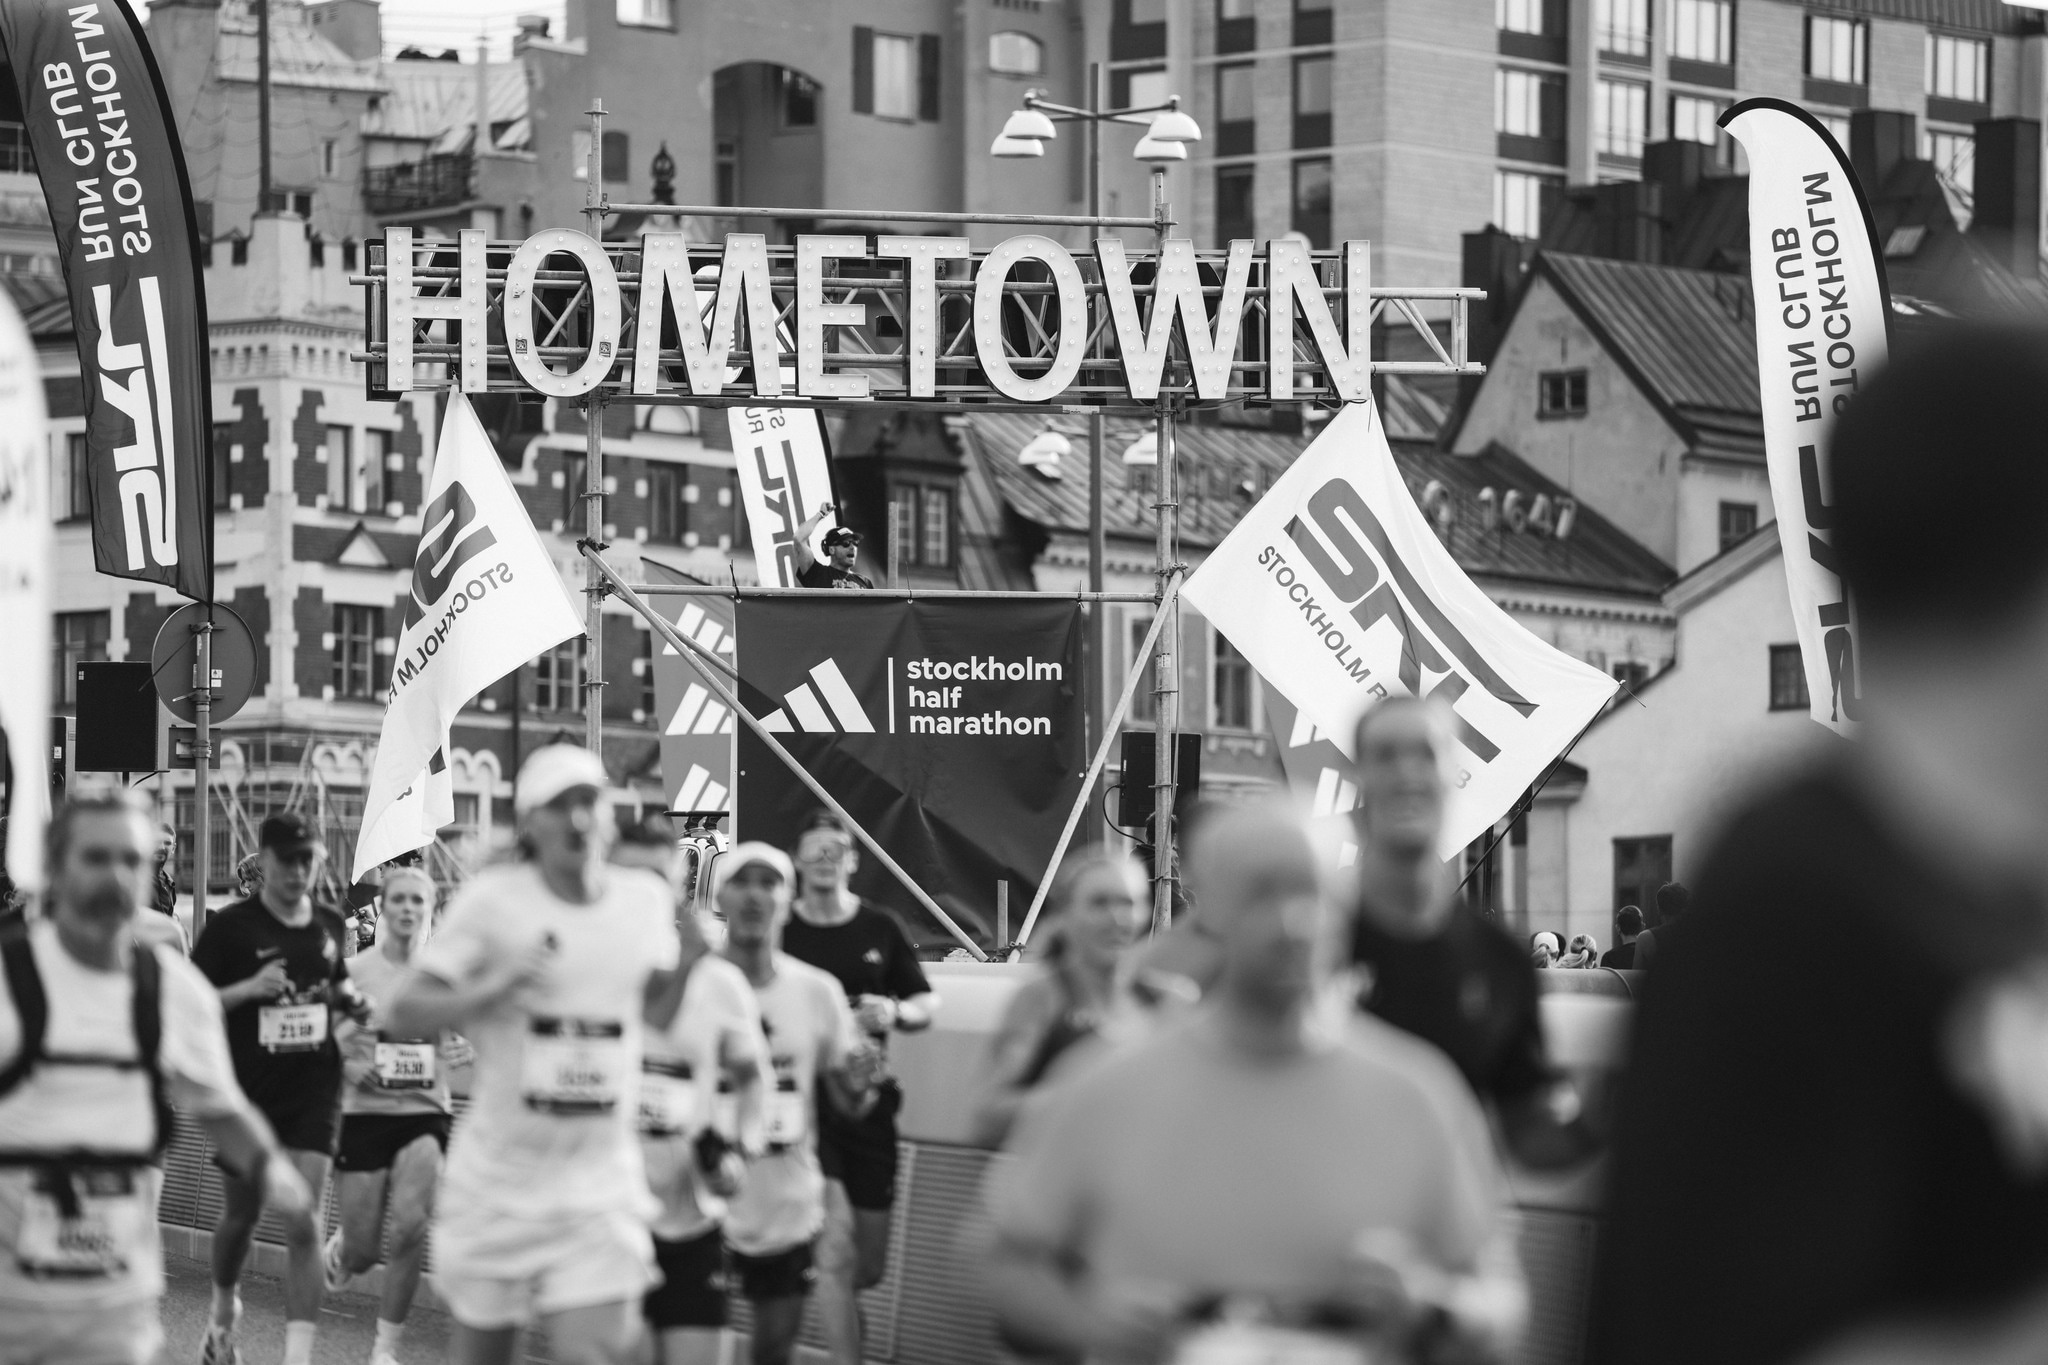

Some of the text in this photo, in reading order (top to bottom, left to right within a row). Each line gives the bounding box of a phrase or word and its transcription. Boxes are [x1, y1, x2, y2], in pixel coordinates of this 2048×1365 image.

[383, 226, 1372, 403] HOMETOWN
[1477, 485, 1578, 541] 1647
[1257, 545, 1372, 684] STOCKHOLM
[906, 655, 1063, 681] stockholm
[908, 685, 963, 709] half
[909, 710, 1052, 736] marathon
